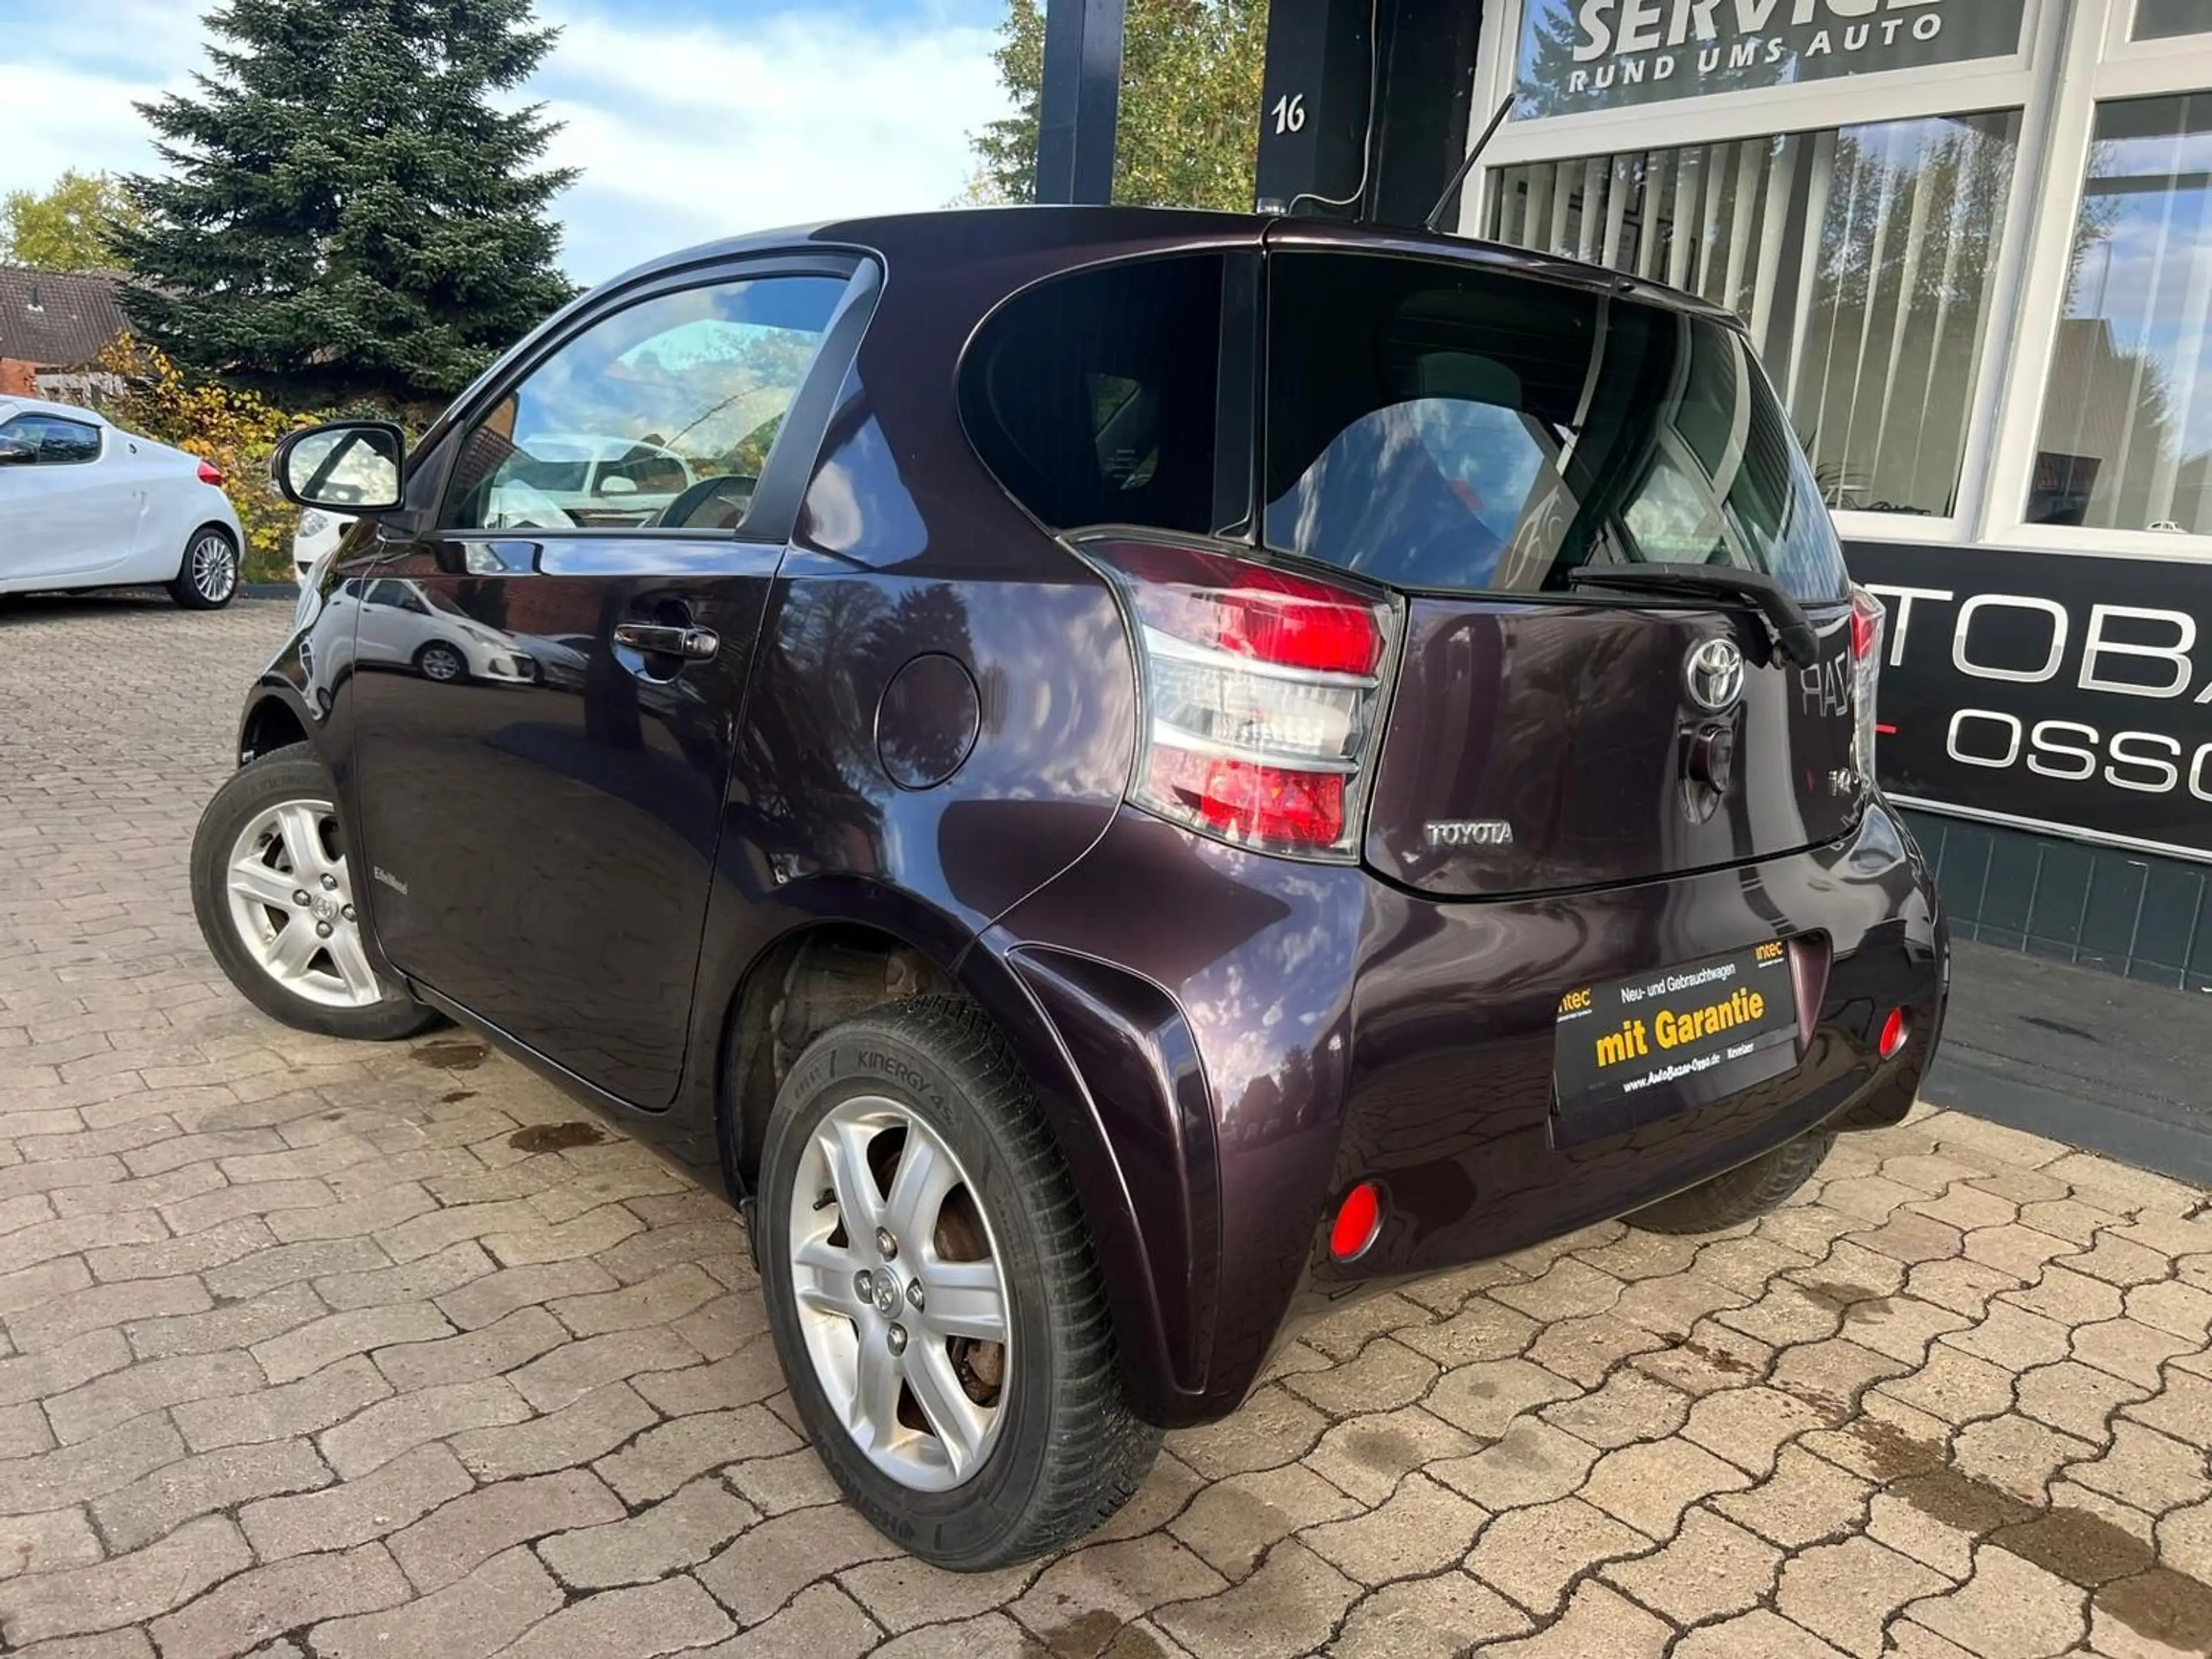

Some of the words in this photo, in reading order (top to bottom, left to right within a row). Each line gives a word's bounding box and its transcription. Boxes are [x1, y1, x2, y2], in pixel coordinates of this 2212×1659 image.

[1569, 56, 1675, 93] RUND
[1698, 37, 1783, 74] UMS
[1804, 13, 1941, 57] AUTO
[1573, 0, 1942, 62] SERV
[1270, 93, 1305, 135] 16
[1864, 584, 2212, 704] TOB
[1426, 821, 1513, 845] TOYOTA
[1620, 987, 1646, 1004] Neu-
[1646, 979, 1666, 997] und
[1666, 963, 1737, 993] Gebrauchtwagen
[1596, 1019, 1649, 1067] mit
[1654, 987, 1764, 1050] Garantie
[857, 1050, 933, 1092] KINERGY
